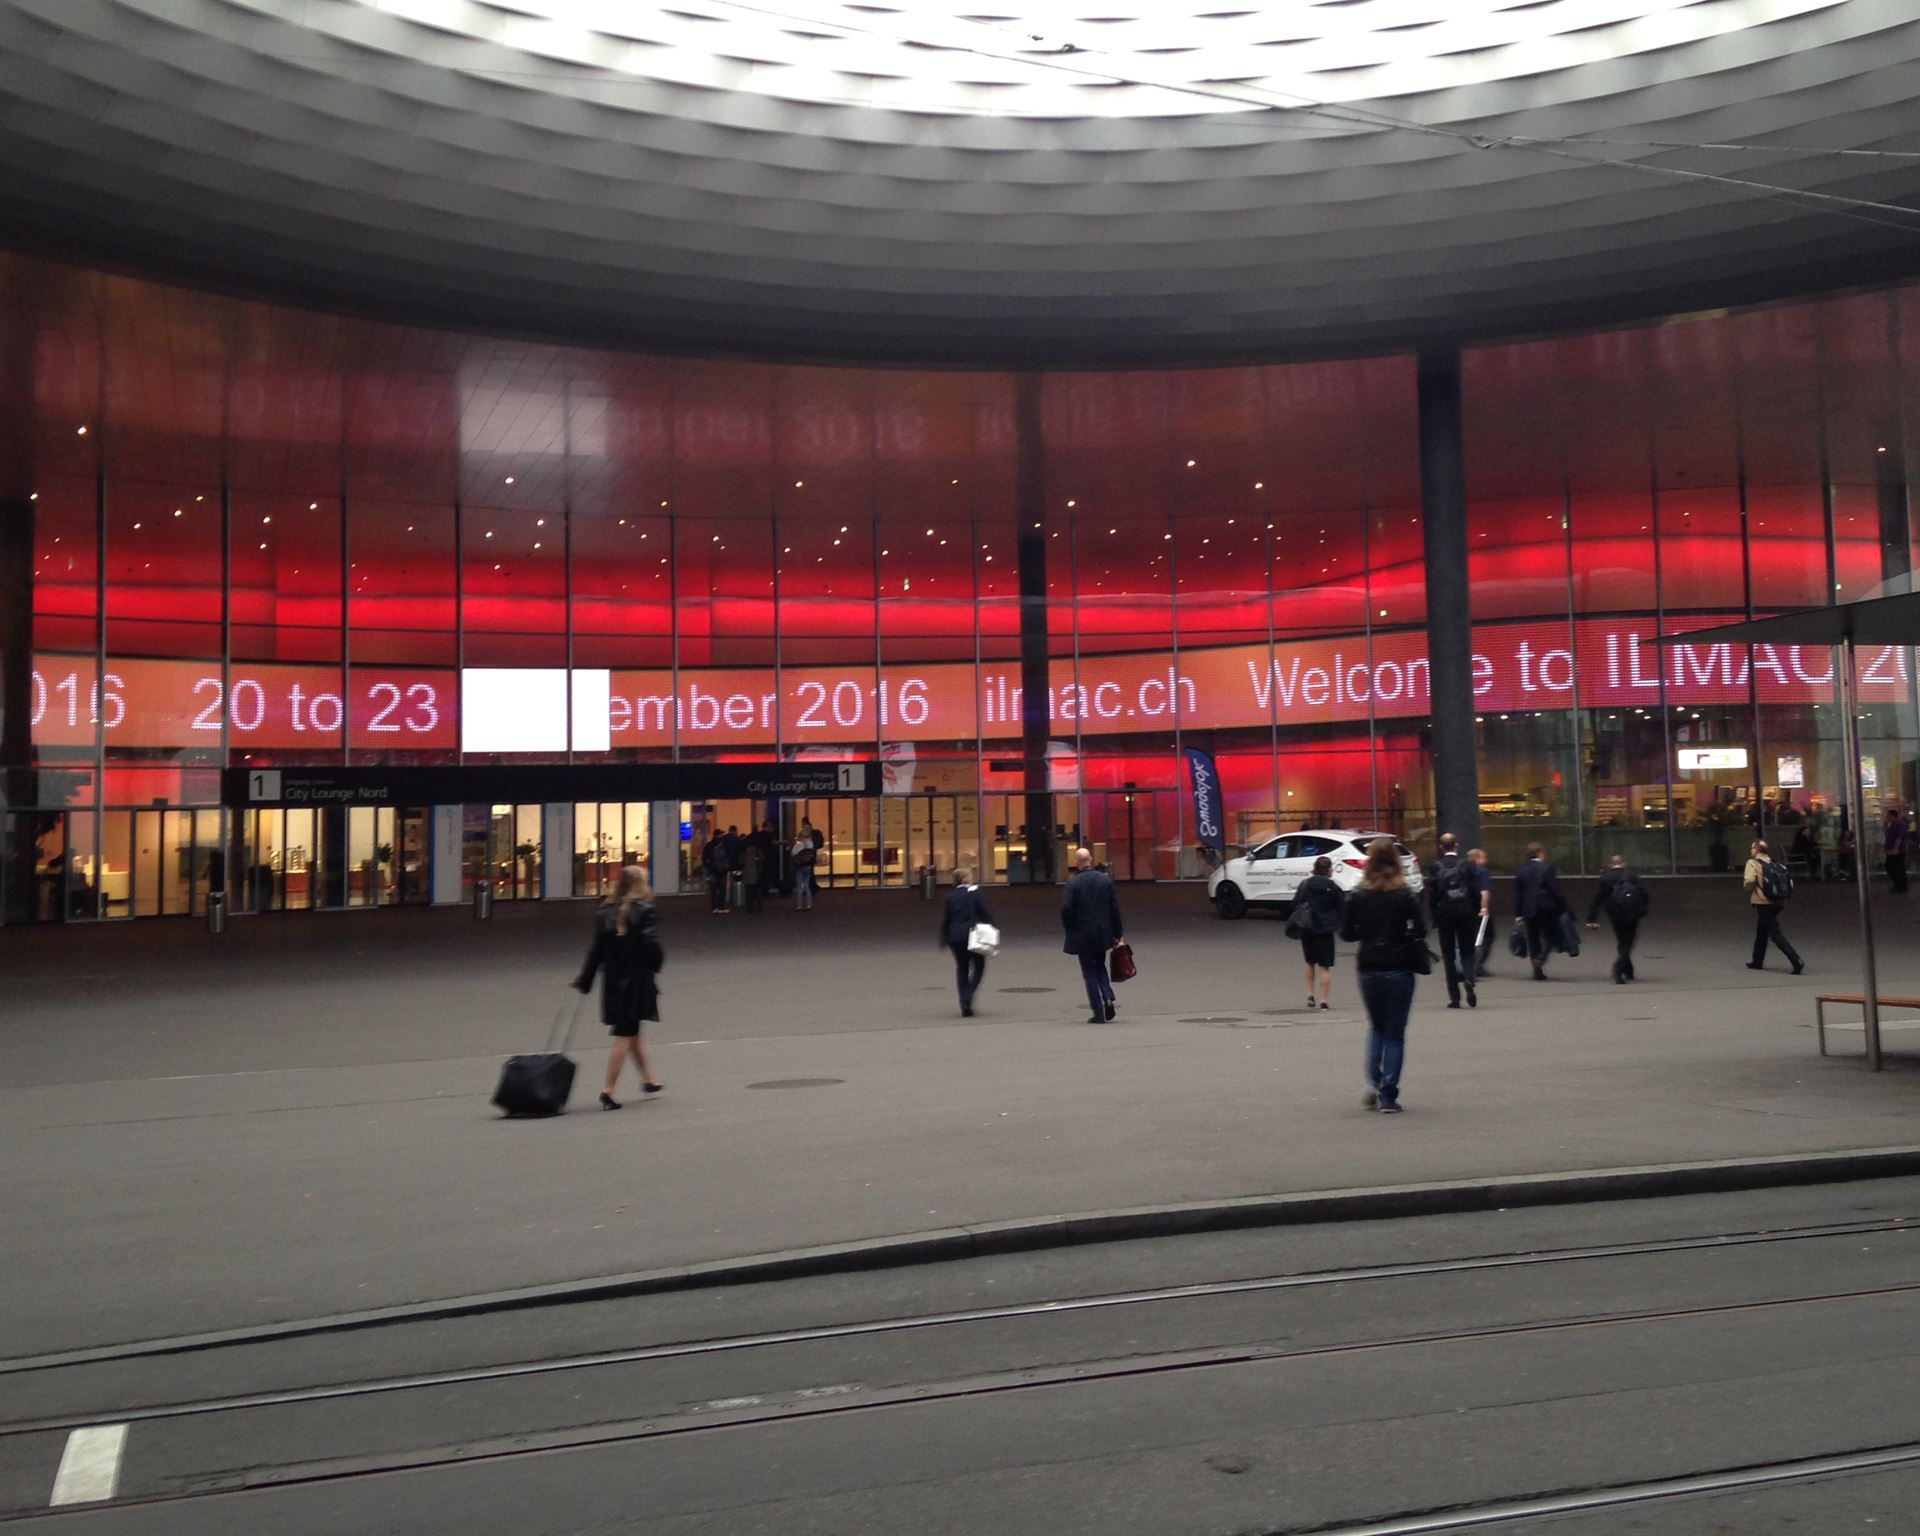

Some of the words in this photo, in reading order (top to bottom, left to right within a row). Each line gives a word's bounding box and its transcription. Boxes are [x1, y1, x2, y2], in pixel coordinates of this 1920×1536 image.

[1514, 640, 1578, 691] to
[191, 678, 265, 731] 20
[288, 683, 343, 731] to
[367, 683, 439, 732] 23
[796, 679, 929, 727] 2016
[254, 774, 264, 797] 1
[285, 788, 309, 801] City
[311, 788, 354, 801] Lounge
[358, 787, 388, 799] Nord
[747, 782, 768, 795] City
[770, 782, 808, 794] Lounge
[810, 780, 835, 791] Nord
[842, 768, 851, 788] 1
